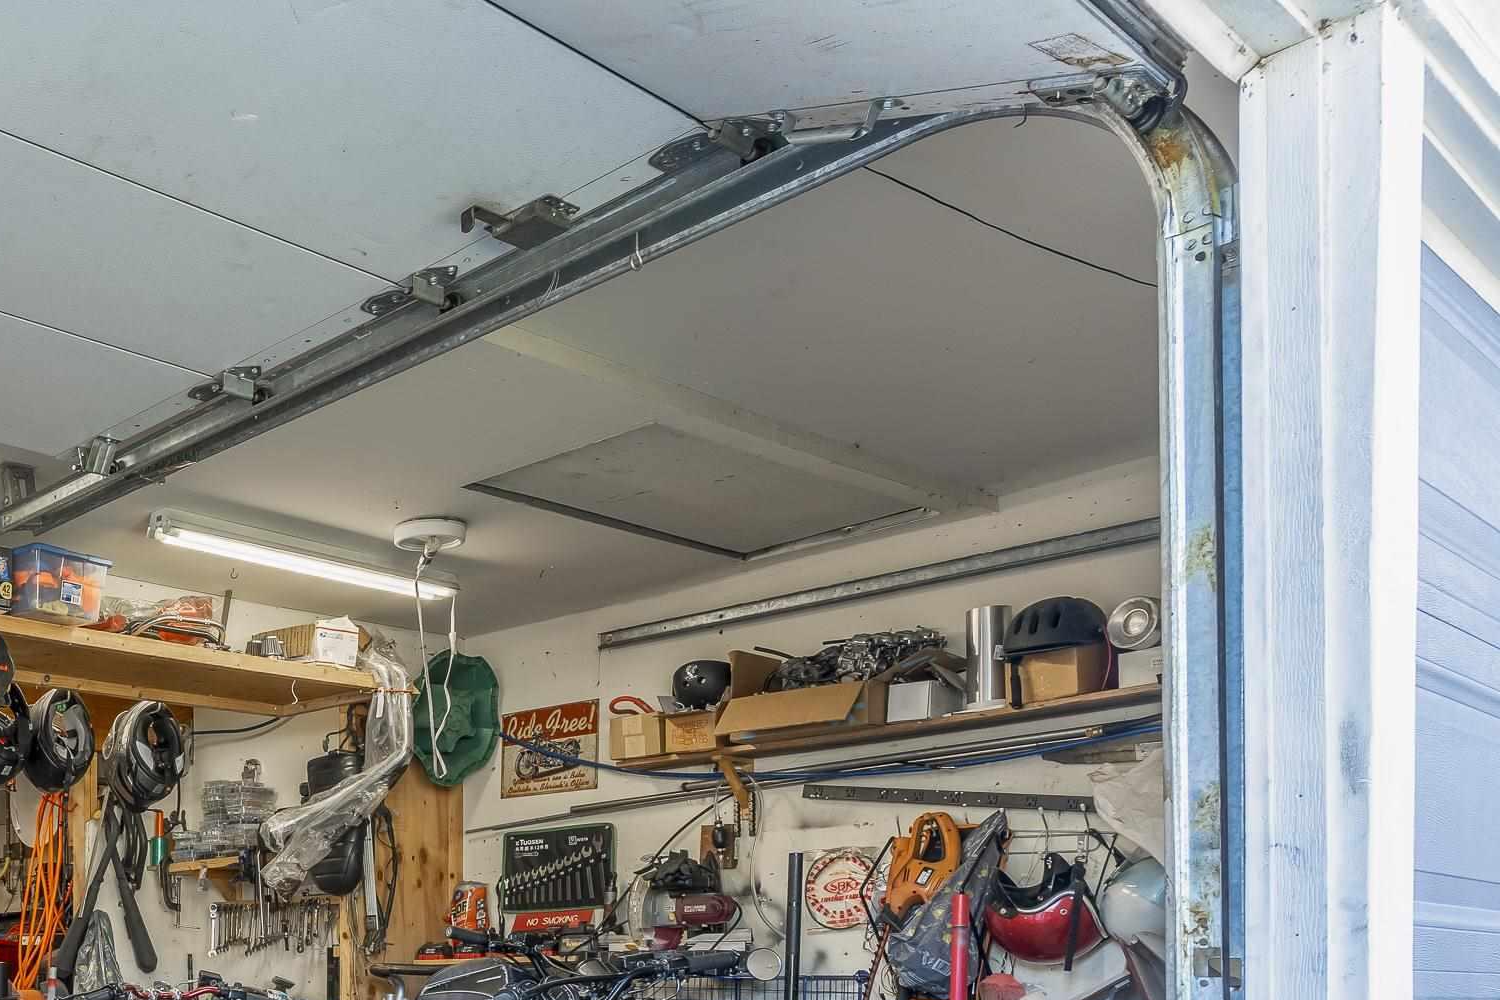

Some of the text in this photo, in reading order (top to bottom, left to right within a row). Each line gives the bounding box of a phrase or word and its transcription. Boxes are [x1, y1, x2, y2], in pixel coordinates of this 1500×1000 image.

[2, 584, 11, 593] 42
[507, 704, 595, 739] Ride Free!
[527, 914, 579, 927] NO SMOKING
